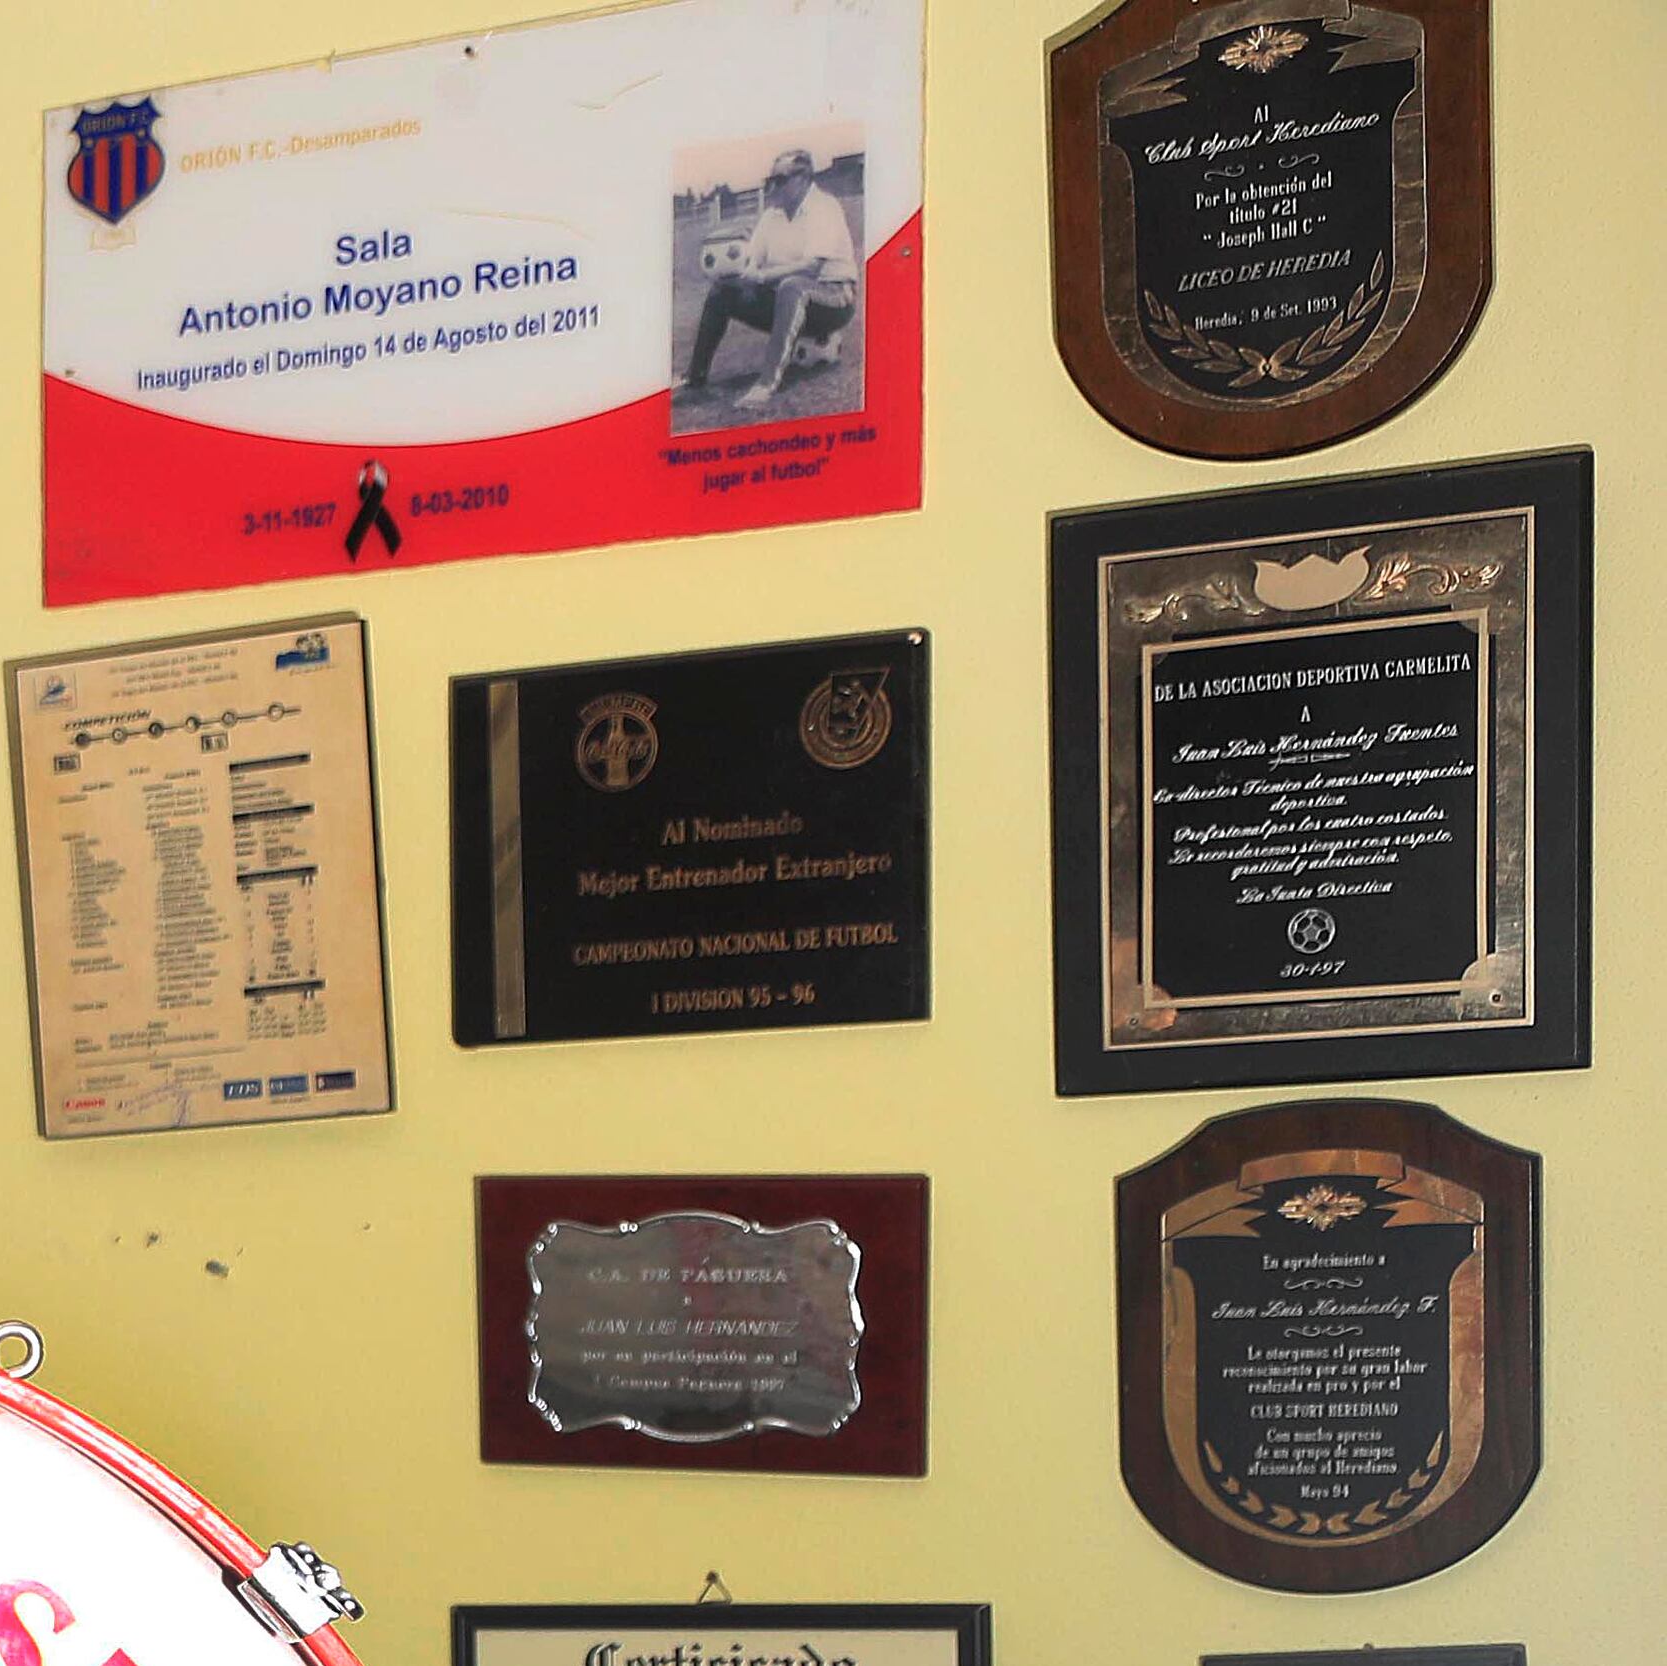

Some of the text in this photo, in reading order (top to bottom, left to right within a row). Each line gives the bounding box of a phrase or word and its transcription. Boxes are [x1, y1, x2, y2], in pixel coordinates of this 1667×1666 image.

[1253, 104, 1270, 124] Al
[1144, 109, 1380, 165] Club Sport Herediano
[180, 144, 242, 173] ORIÓN
[1194, 170, 1333, 210] Por la obtención del
[1229, 205, 1267, 225] título
[335, 229, 411, 266] Sala
[1216, 217, 1314, 249] Joseph Hall C
[1177, 248, 1353, 292] LICEO DE HEREDIA
[179, 255, 577, 338] Antonio Moyano Reina
[1263, 304, 1278, 320] de
[1307, 295, 1338, 314] 1993
[137, 304, 601, 391] Inaugurado el Domingo 14 de Agosto del 2011
[727, 425, 877, 460] cachondeo más
[702, 465, 766, 494] jugar al
[1154, 652, 1472, 703] DE LA ASOCIACION DEPORTIVA CARMELITA
[1300, 704, 1312, 723] A
[1172, 726, 1379, 764] Juan Luis Hernández
[1241, 777, 1302, 798] Técnico
[660, 810, 805, 847] Al Nominado
[578, 848, 894, 899] Mejor Entrenador Extranjero
[1264, 883, 1312, 903] Junta
[1316, 879, 1394, 899] Directiva
[571, 921, 900, 968] CAMPEONATO NACIONAL DE FUTBOL
[663, 980, 816, 1015] DIVISION 95 96
[1262, 1252, 1374, 1272] En agradecimiento
[1211, 1301, 1257, 1319] Juan
[1260, 1299, 1304, 1319] Luis
[1308, 1296, 1411, 1320] Hernández
[1347, 1344, 1401, 1362] presente
[1249, 1403, 1284, 1419] CLUB
[1327, 1401, 1400, 1419] HEREDIANO
